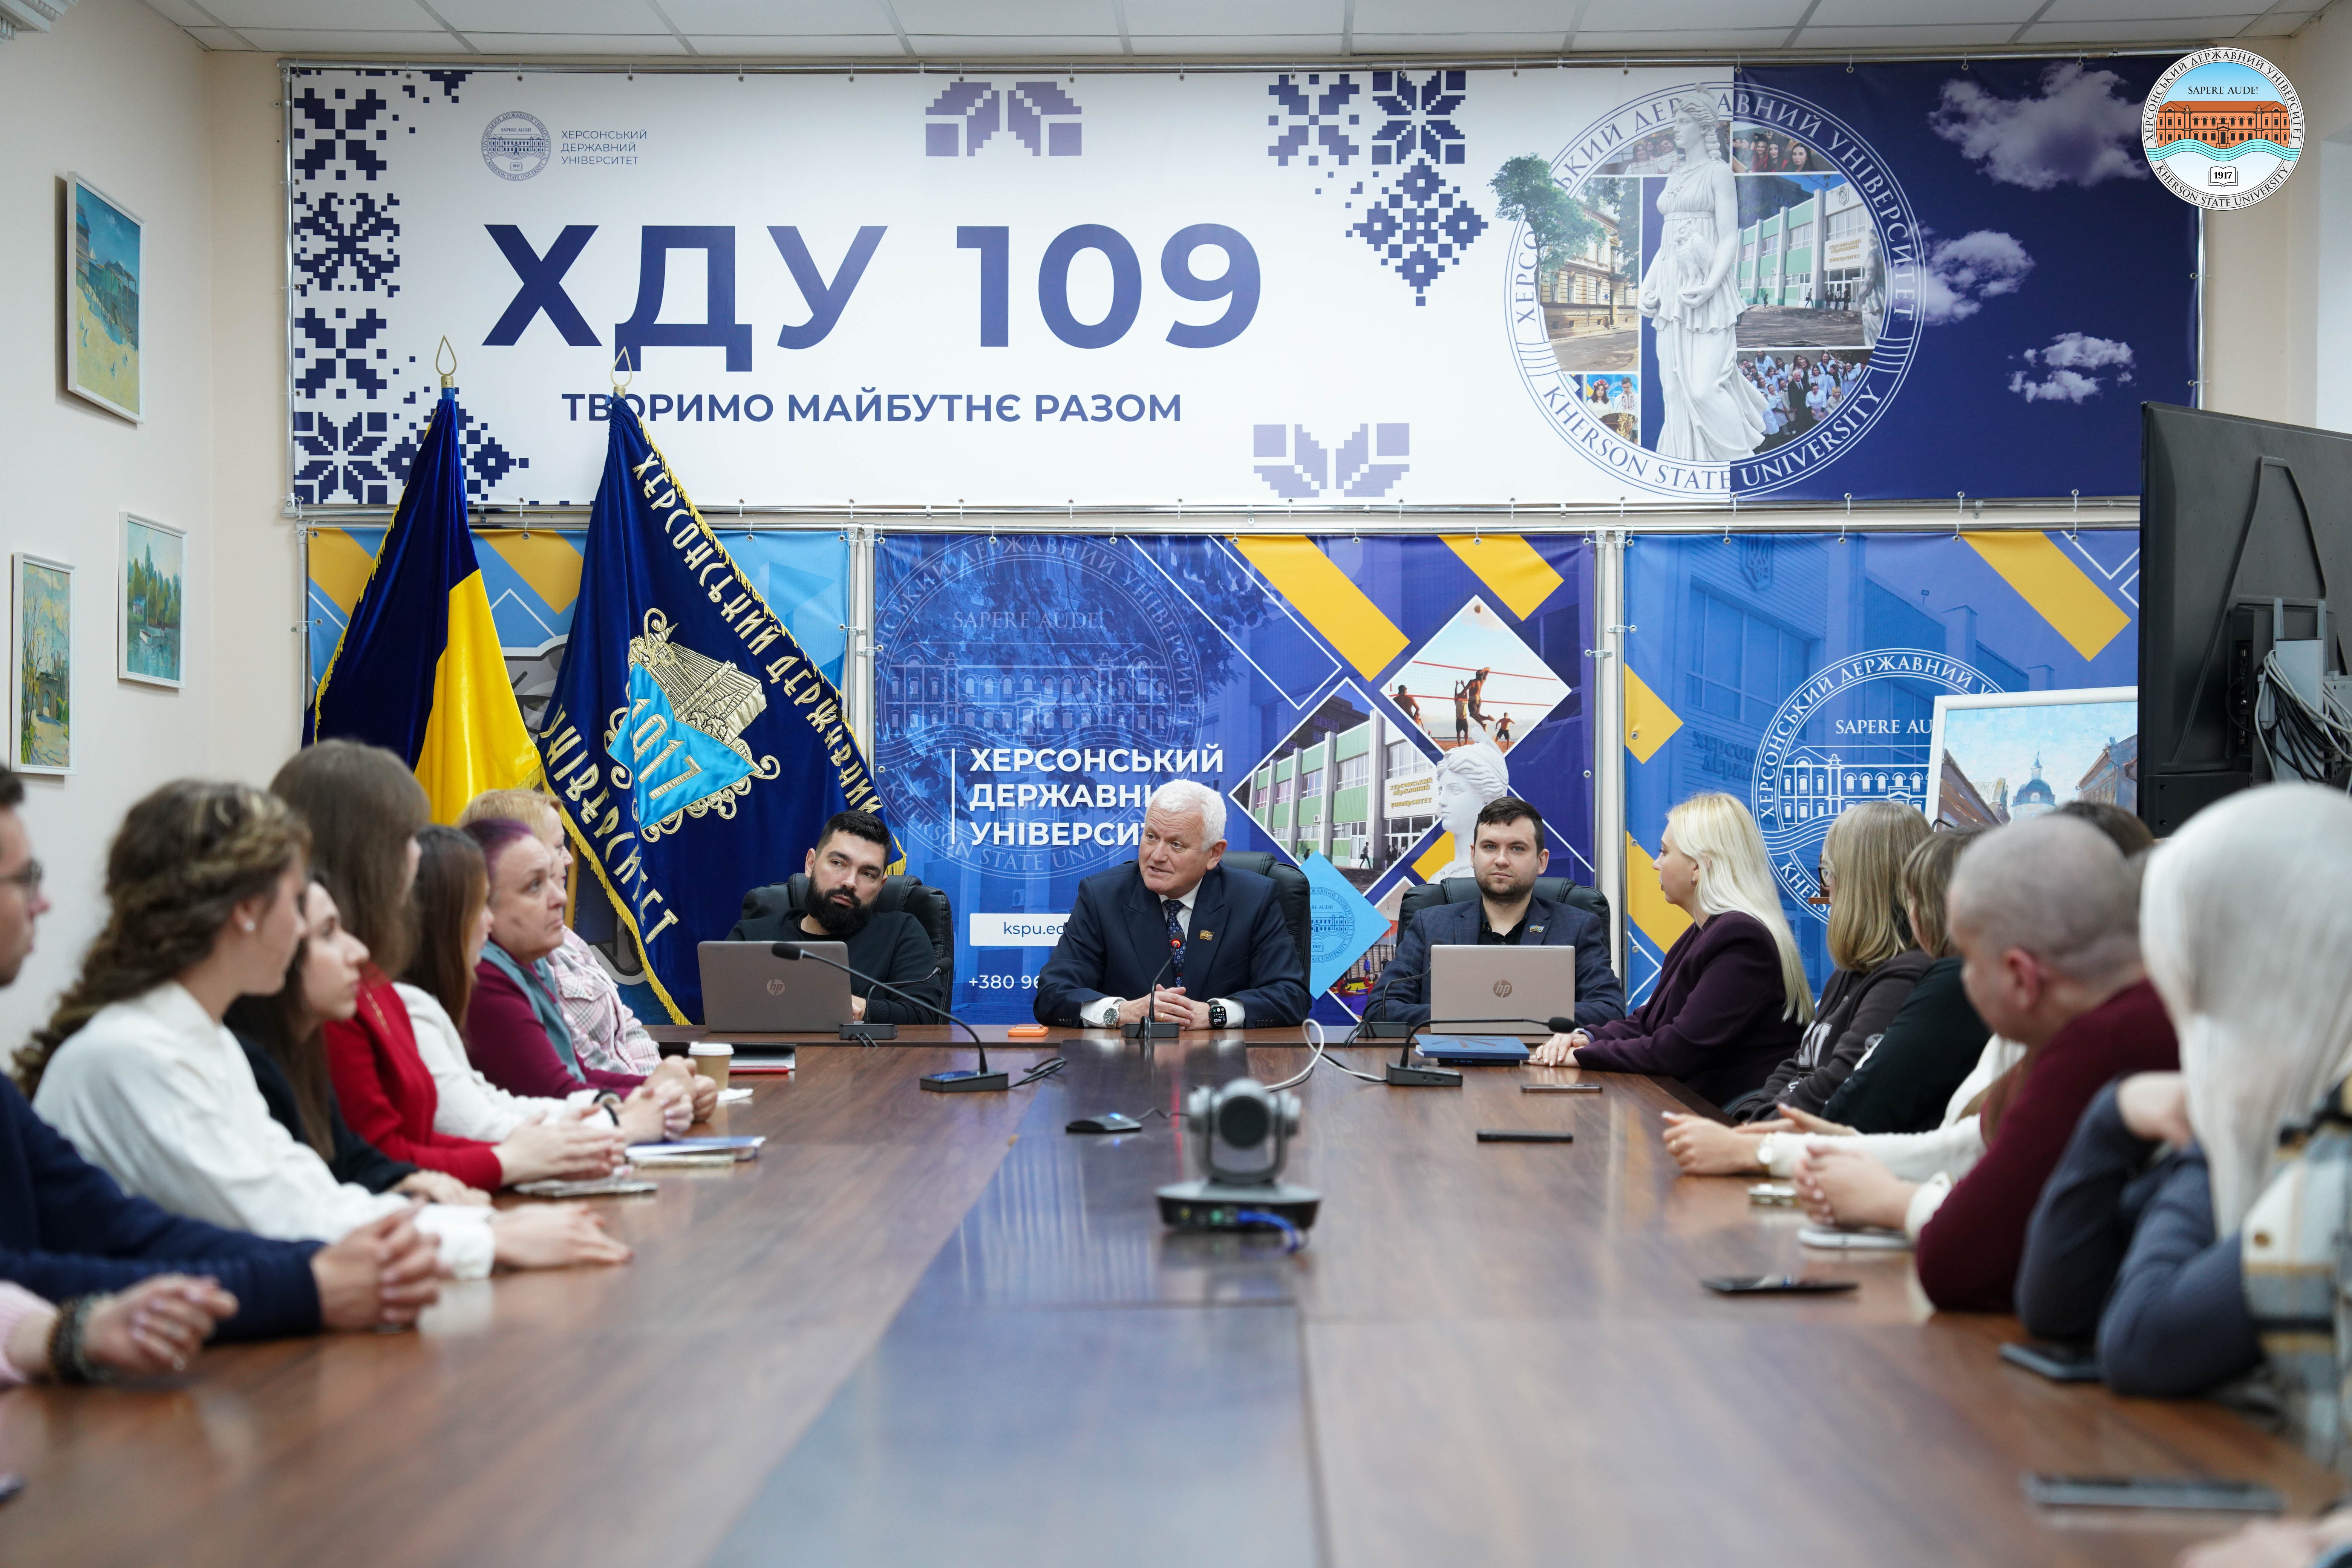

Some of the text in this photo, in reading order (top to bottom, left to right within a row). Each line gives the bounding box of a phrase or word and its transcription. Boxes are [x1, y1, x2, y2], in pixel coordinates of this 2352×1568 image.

[483, 118, 501, 151] ХЕРСОНСЬКИЙ
[535, 120, 549, 151] УНІВЕРСИТЕТ
[561, 129, 647, 139] ХЕРСОНСЬКИЙ
[561, 142, 636, 153] ДЕРЖАВНИЙ
[488, 161, 506, 178] KHERSON
[521, 162, 544, 179] UNIVERSITY
[561, 156, 639, 165] УНІВЕРСИТЕТ
[1635, 92, 1822, 139] ДЕРАВНИЙ
[1827, 130, 1915, 321] УНІВЕРСИТЕТ
[481, 222, 1262, 372] ХДУ 109
[788, 387, 1021, 423] МАЙБУТНЄ
[1036, 393, 1182, 423] РАЗОМ
[1544, 385, 1882, 490] KHERSON STATE UNIVERSITY
[632, 451, 781, 655] ХЕРСОНСЬКИЙ
[953, 611, 1103, 629] SAPERE AUDE!
[1122, 570, 1194, 726] УНІВЕРСИТЕТ
[1760, 655, 1973, 818] ХЕРСОНСЬКИЙ ДЕРЖАВНИЙ
[1836, 719, 1900, 734] SAPERE
[970, 743, 1224, 772] ХЕРСОНСЬКИЙ
[969, 784, 1151, 811] ДЕРЖАВН
[971, 822, 1145, 846] УНІВЕРСИ
[980, 848, 1044, 871] STATE
[1311, 889, 1336, 897] ЖАВНИЙ
[1321, 942, 1348, 961] UNIVERSITY
[767, 978, 784, 995] hp
[969, 975, 1014, 989] +380
[1494, 980, 1512, 998] hp
